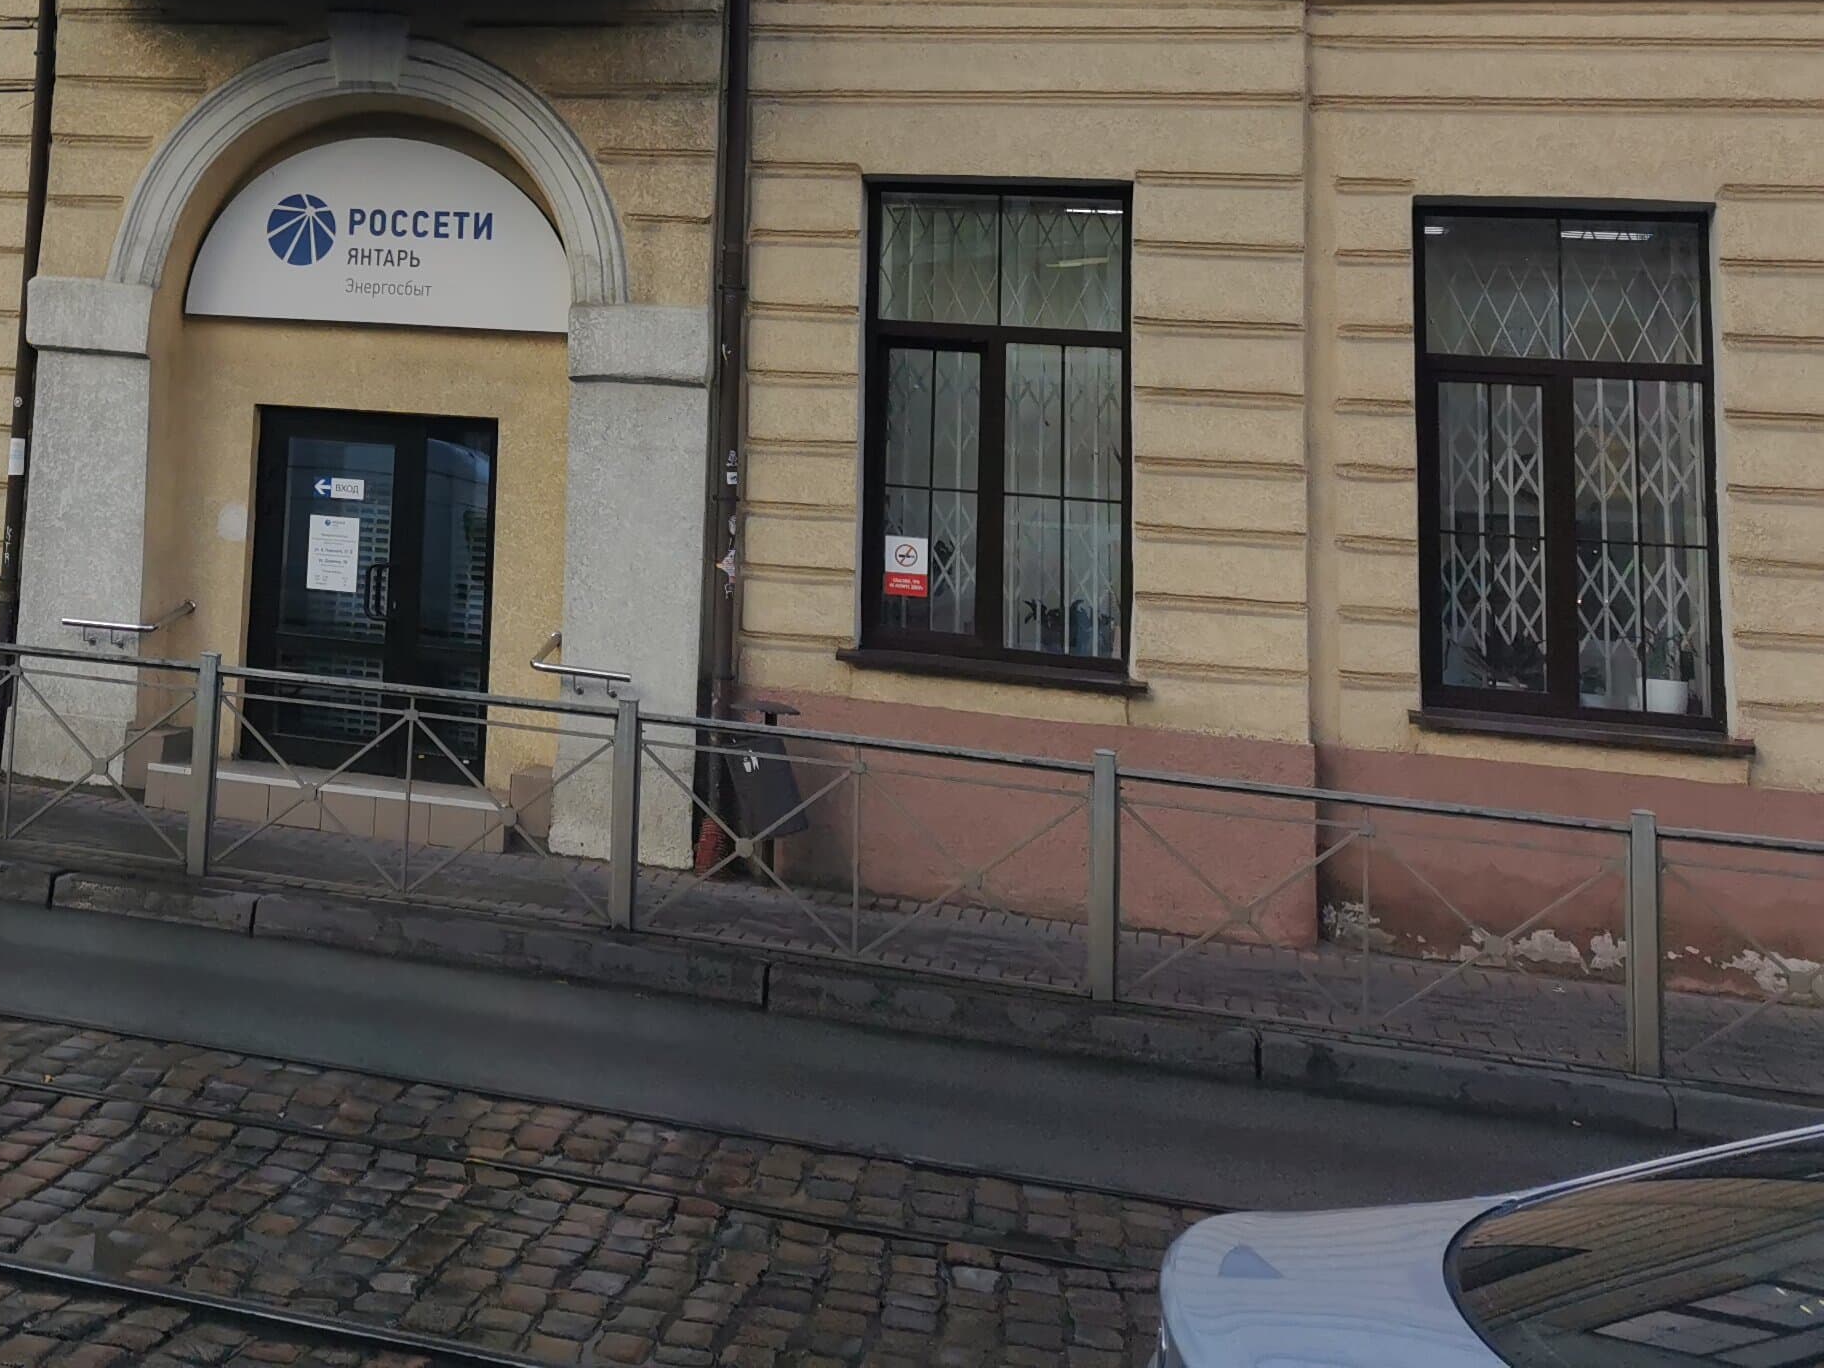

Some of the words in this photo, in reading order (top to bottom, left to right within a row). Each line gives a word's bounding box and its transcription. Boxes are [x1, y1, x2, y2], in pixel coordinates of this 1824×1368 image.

[348, 208, 493, 240] РОССЕТИ
[347, 247, 421, 268] ЯНТАРЬ
[345, 277, 433, 298] Энергосбыт
[335, 484, 360, 494] ВХОД
